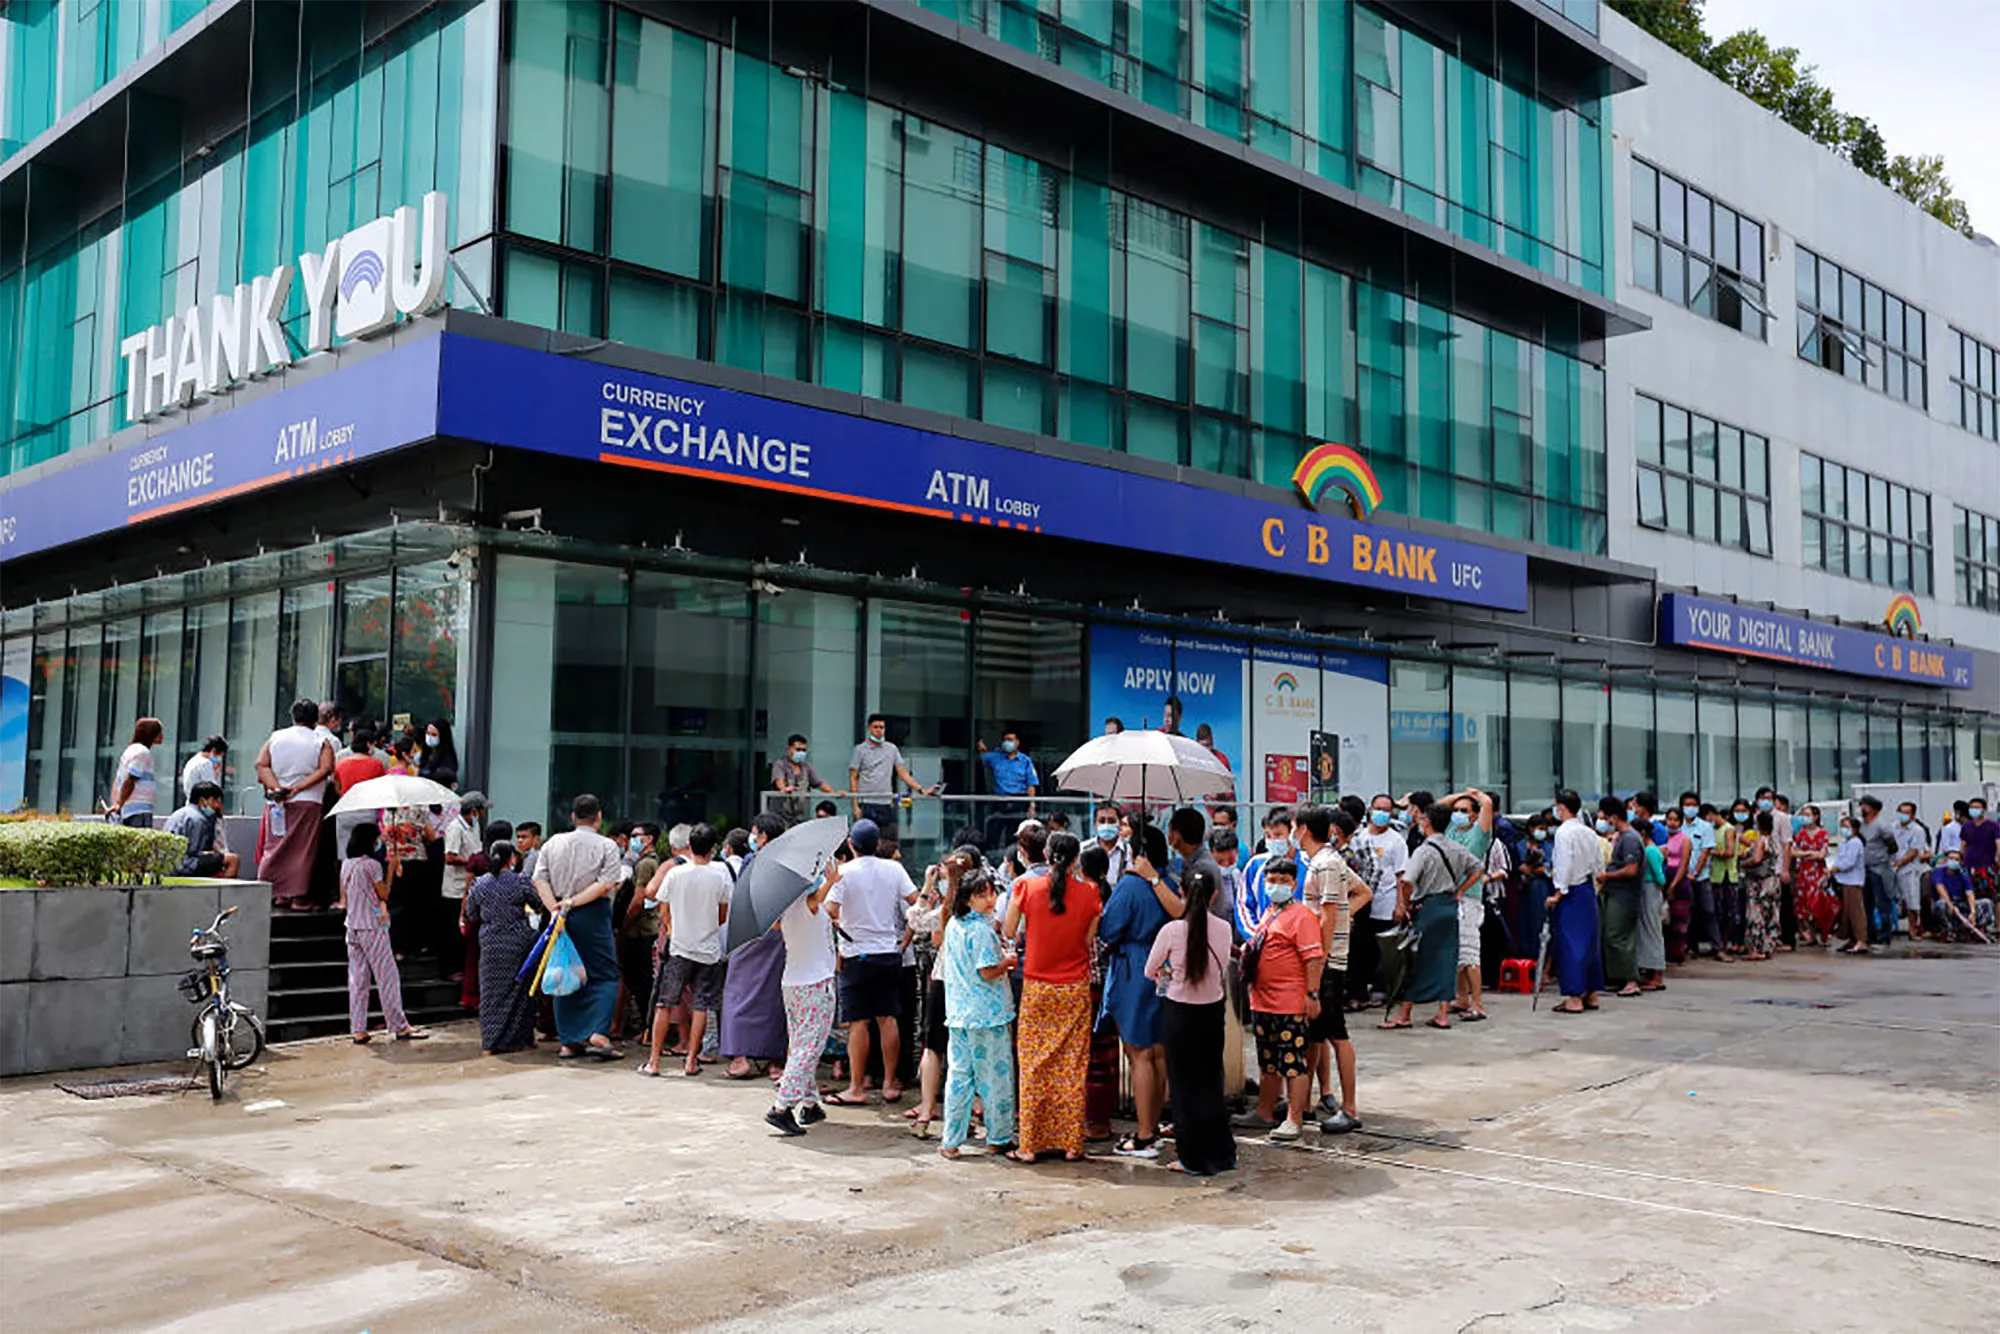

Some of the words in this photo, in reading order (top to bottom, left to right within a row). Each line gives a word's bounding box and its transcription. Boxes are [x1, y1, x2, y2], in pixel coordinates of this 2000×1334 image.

[121, 265, 293, 421] THANK
[602, 382, 705, 417] CURRENCY
[274, 416, 318, 465] ATM
[320, 424, 355, 450] LOBBY
[601, 407, 811, 478] EXCHANGE
[128, 452, 214, 506] EXCHANGE
[926, 469, 990, 510] ATM
[995, 497, 1041, 518] LOBBY
[0, 516, 16, 545] FC
[1262, 518, 1286, 557] C
[1307, 524, 1330, 565] B
[1353, 534, 1438, 583] BANK
[1452, 562, 1482, 590] UFC
[1687, 607, 1731, 642] YOUR
[1738, 617, 1792, 654] DIGITAL
[1797, 629, 1836, 660] BANK
[1124, 667, 1172, 692] APPLY
[1177, 671, 1215, 695] NOW
[1874, 643, 1885, 669] C
[1892, 648, 1902, 671] B
[1909, 650, 1945, 678] BANK
